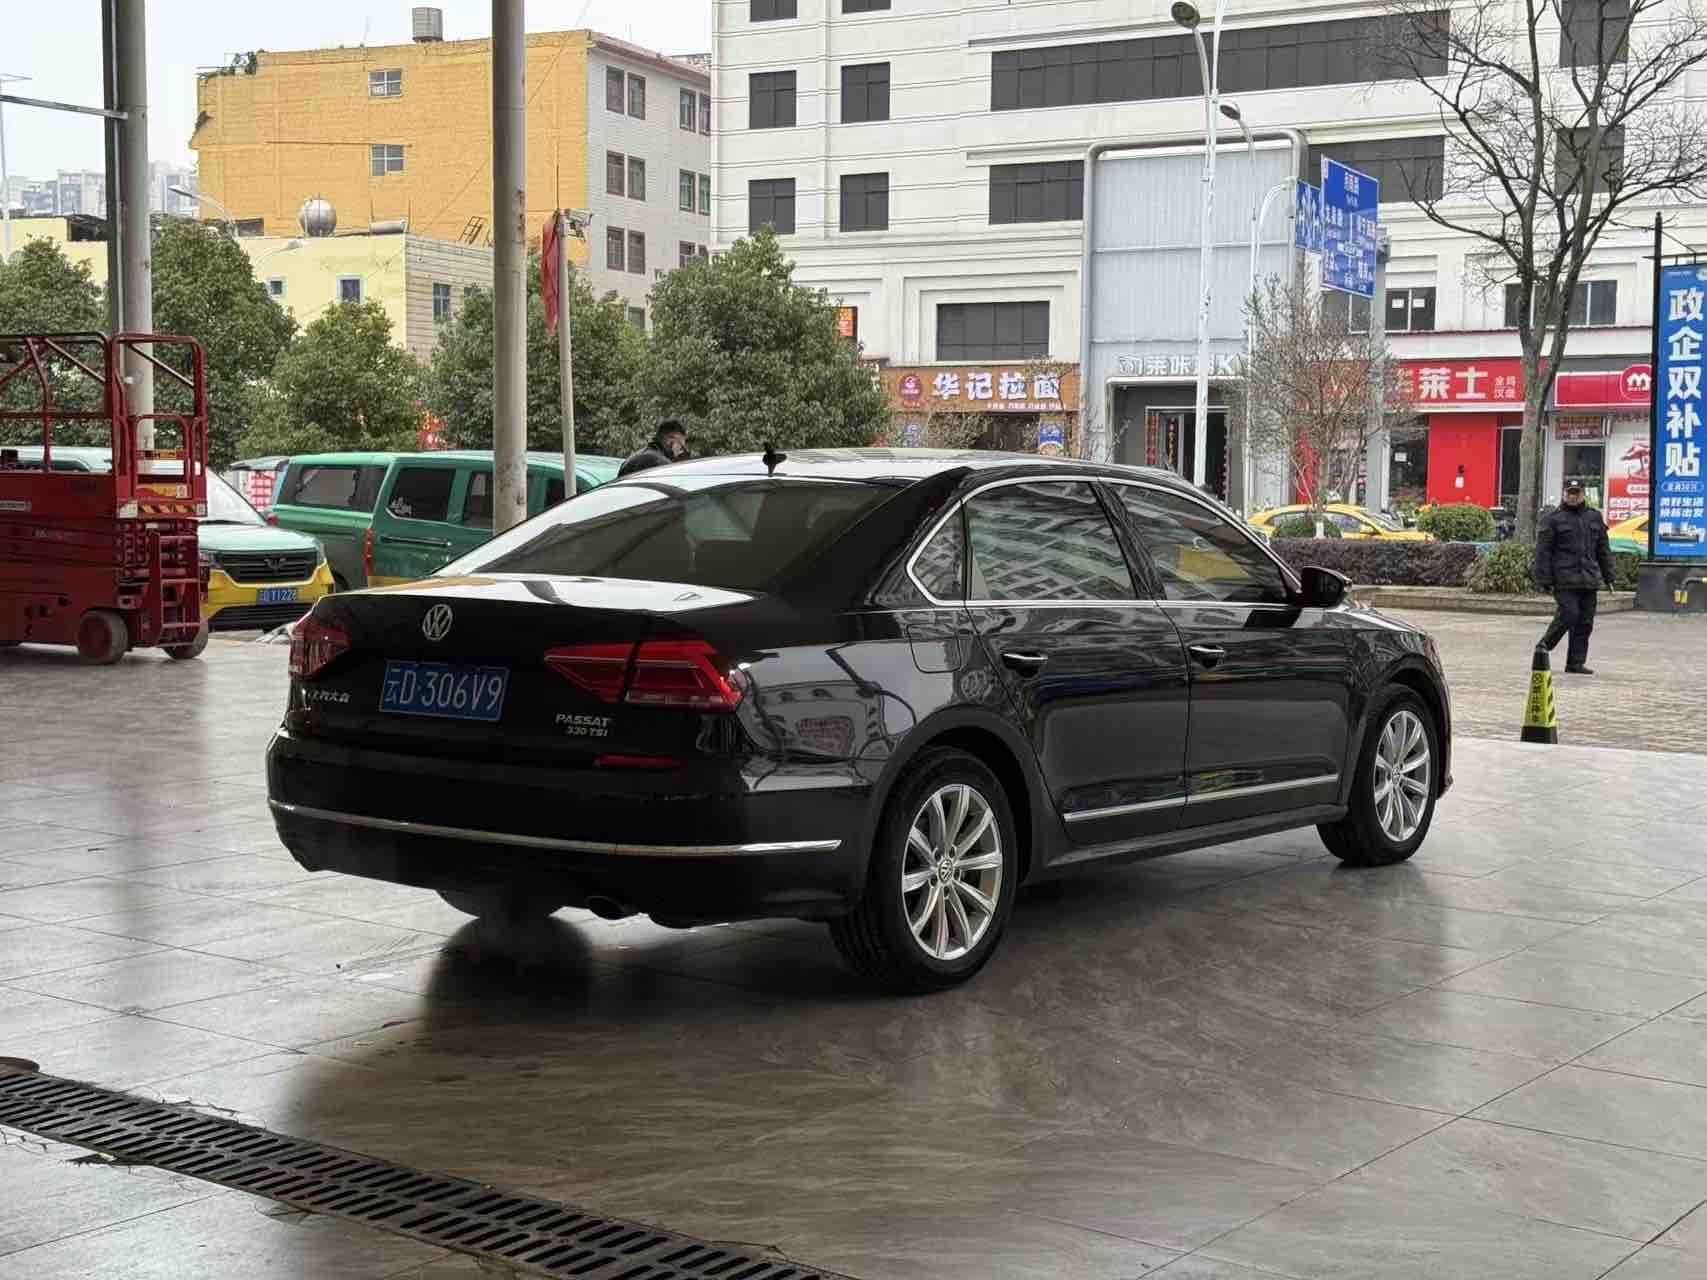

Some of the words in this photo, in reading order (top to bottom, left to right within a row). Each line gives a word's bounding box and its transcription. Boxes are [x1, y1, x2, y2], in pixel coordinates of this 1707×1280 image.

[931, 371, 1059, 400] 华记拉面
[1665, 287, 1704, 477] 政企双补贴
[555, 713, 610, 728] PASSAT
